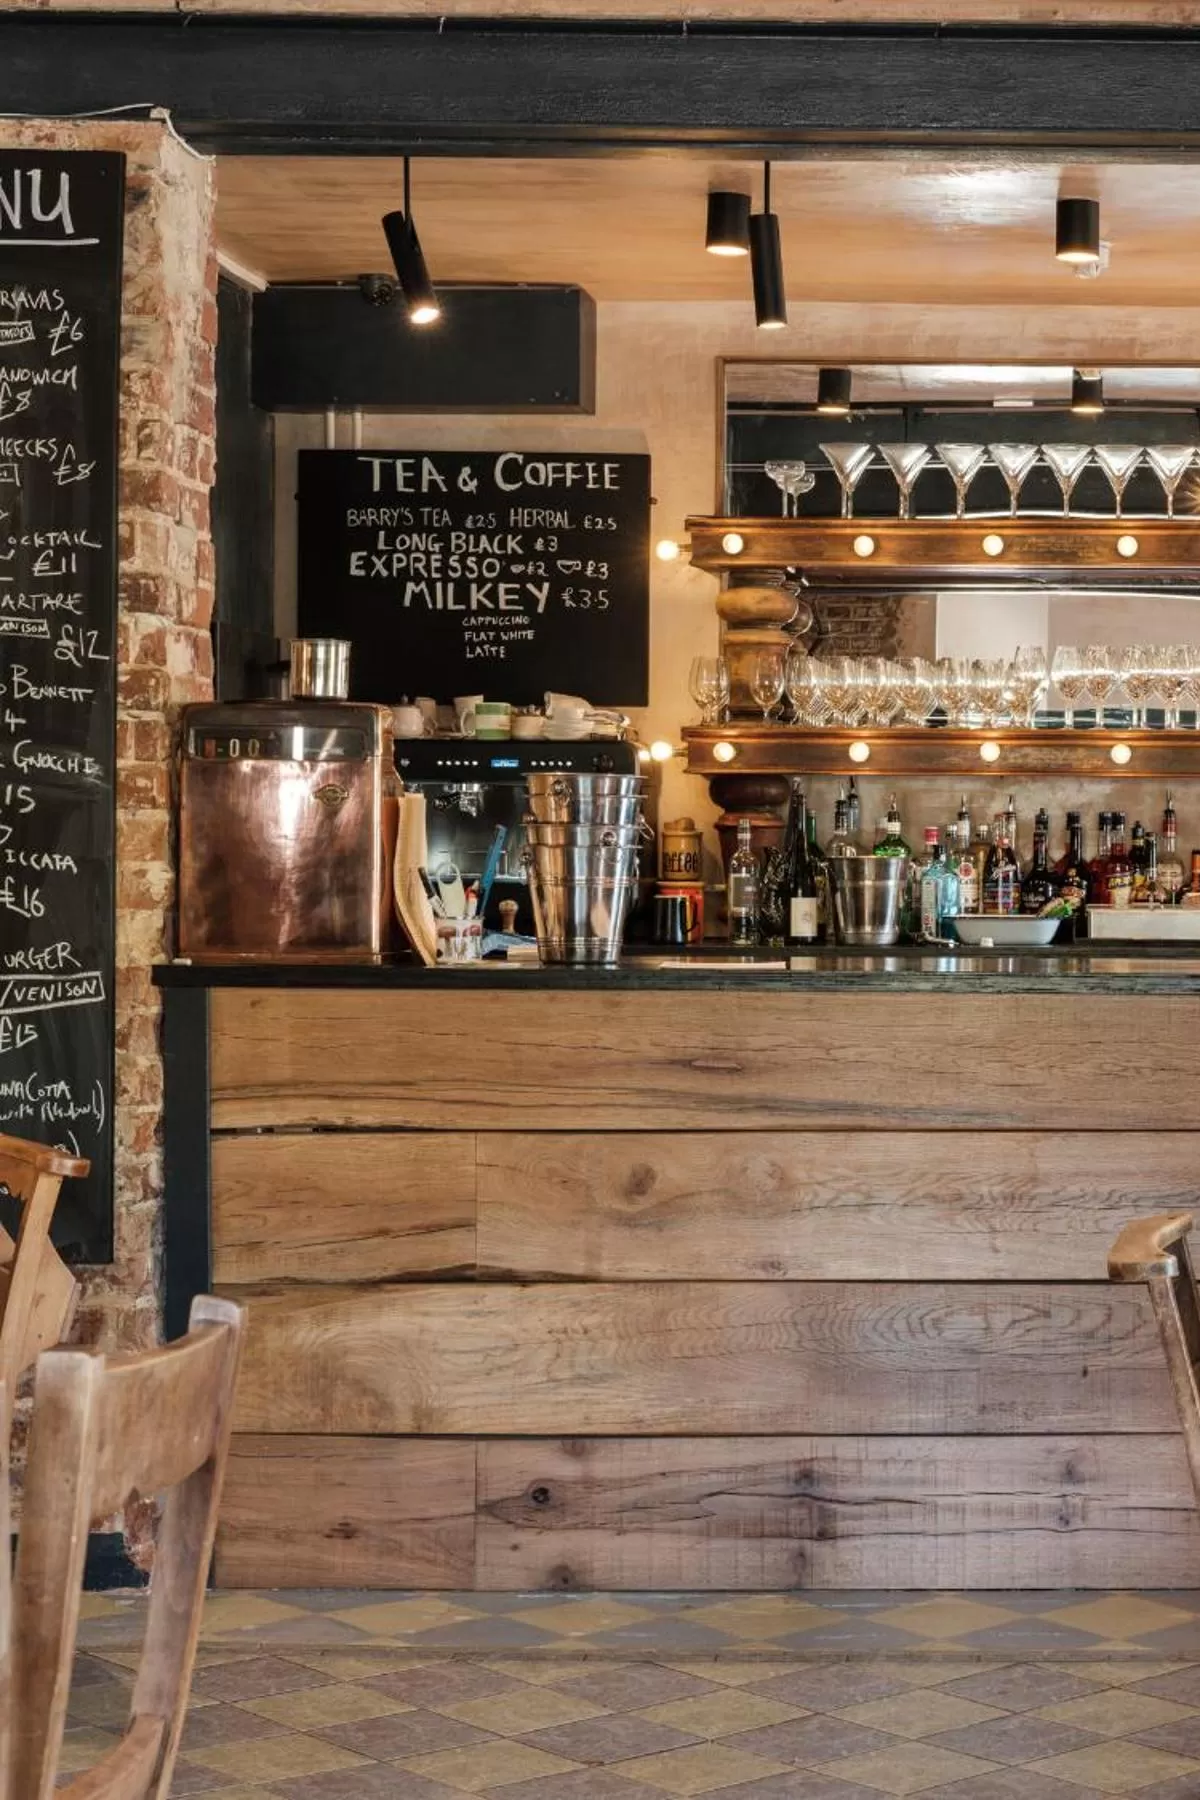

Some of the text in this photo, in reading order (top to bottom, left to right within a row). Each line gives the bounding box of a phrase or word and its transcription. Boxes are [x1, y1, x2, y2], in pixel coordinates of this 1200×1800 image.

[357, 452, 620, 494] TEA & COFFEE
[346, 508, 414, 527] BARRY'S
[420, 508, 451, 527] TEA
[509, 508, 576, 529] HERBAL
[377, 530, 558, 555] LONG BLACK £3
[350, 551, 501, 579] EXPRESSO
[403, 582, 550, 614] MILKEY
[462, 615, 530, 626] CAPPUCCINO
[465, 629, 536, 642] FLAT WHITE
[466, 646, 507, 658] LATTE
[10, 664, 94, 702] BENNETT
